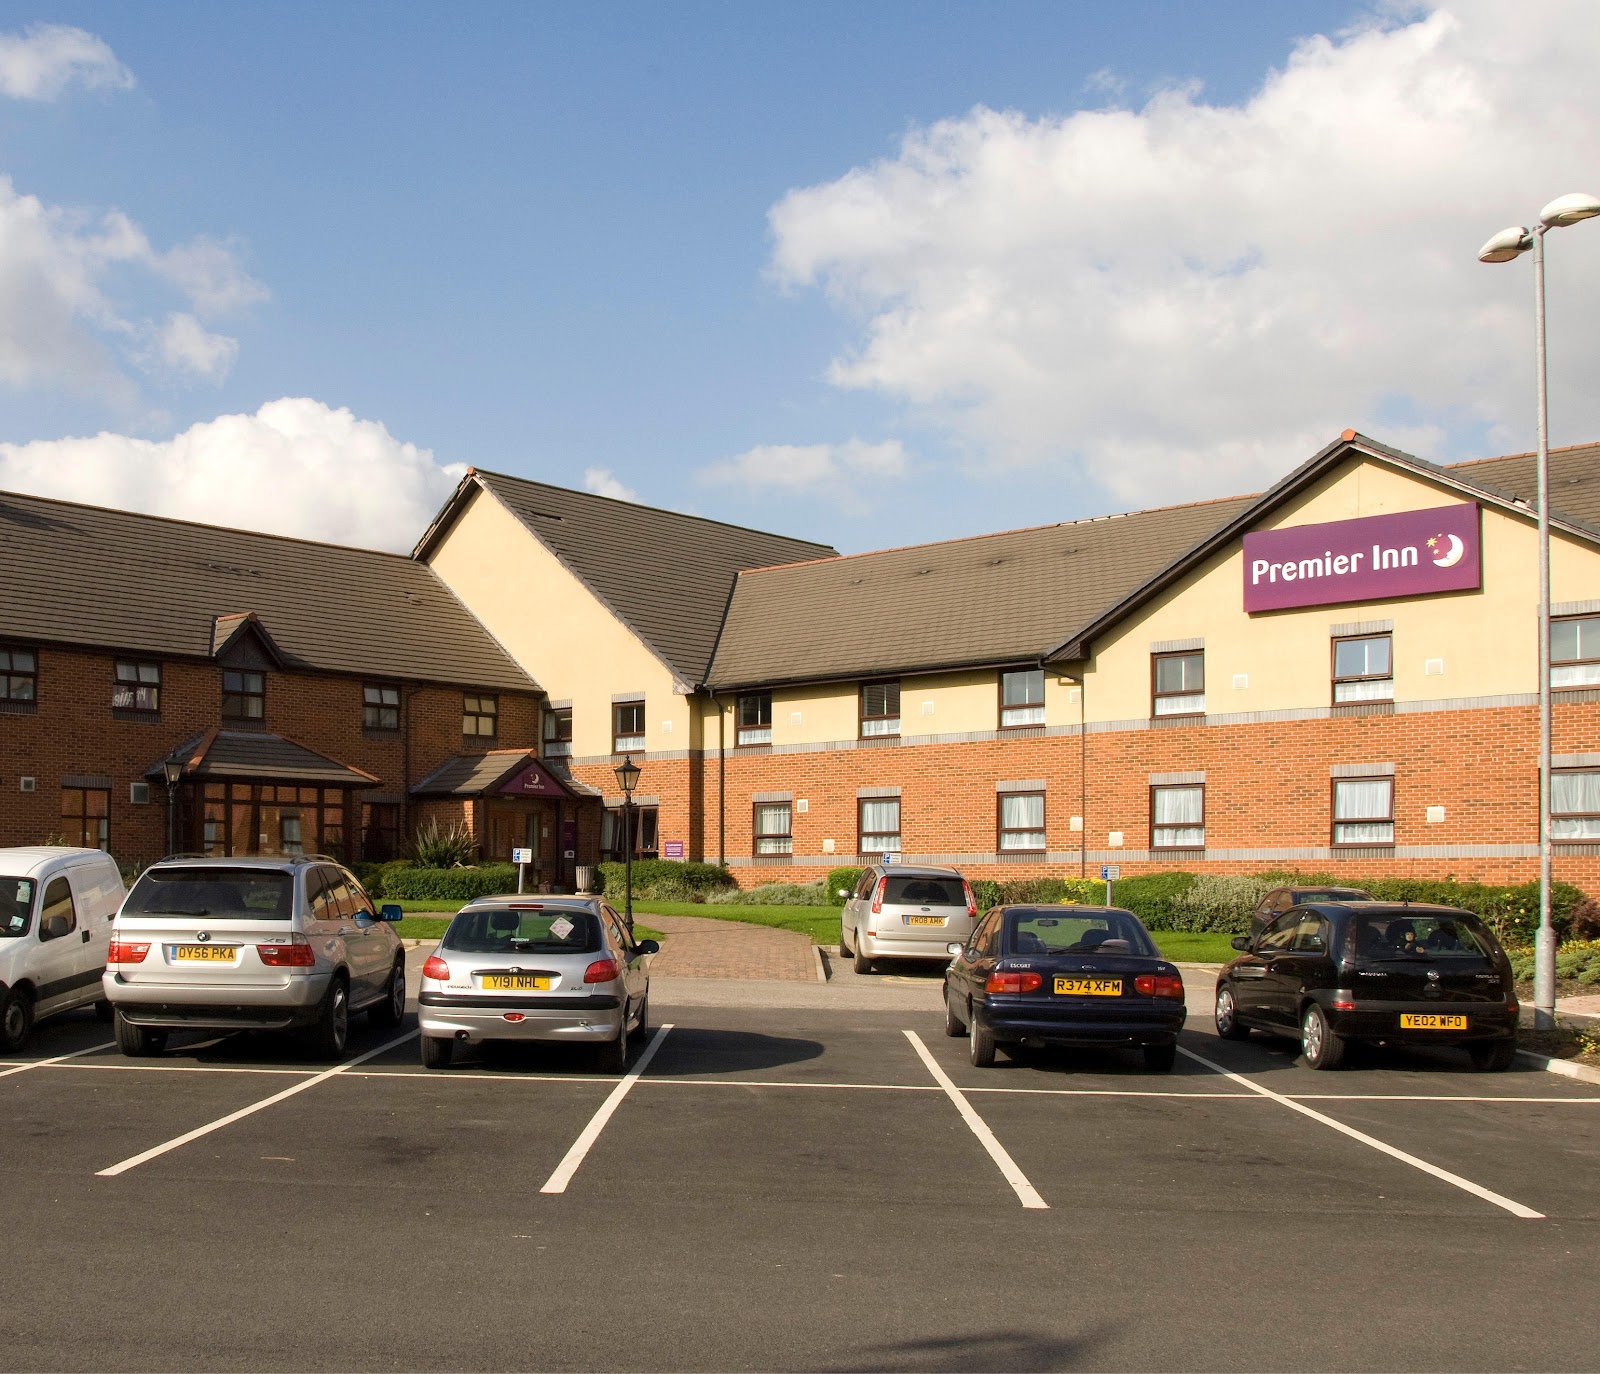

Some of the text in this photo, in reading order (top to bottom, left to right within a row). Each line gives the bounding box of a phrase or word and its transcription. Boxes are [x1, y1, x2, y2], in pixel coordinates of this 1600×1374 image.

[1252, 544, 1418, 585] Premier Inn
[211, 947, 234, 959] PKA
[492, 976, 540, 988] Y191 NHL
[1056, 980, 1121, 992] R374 XFM
[1406, 1015, 1462, 1027] YE02 WFO
